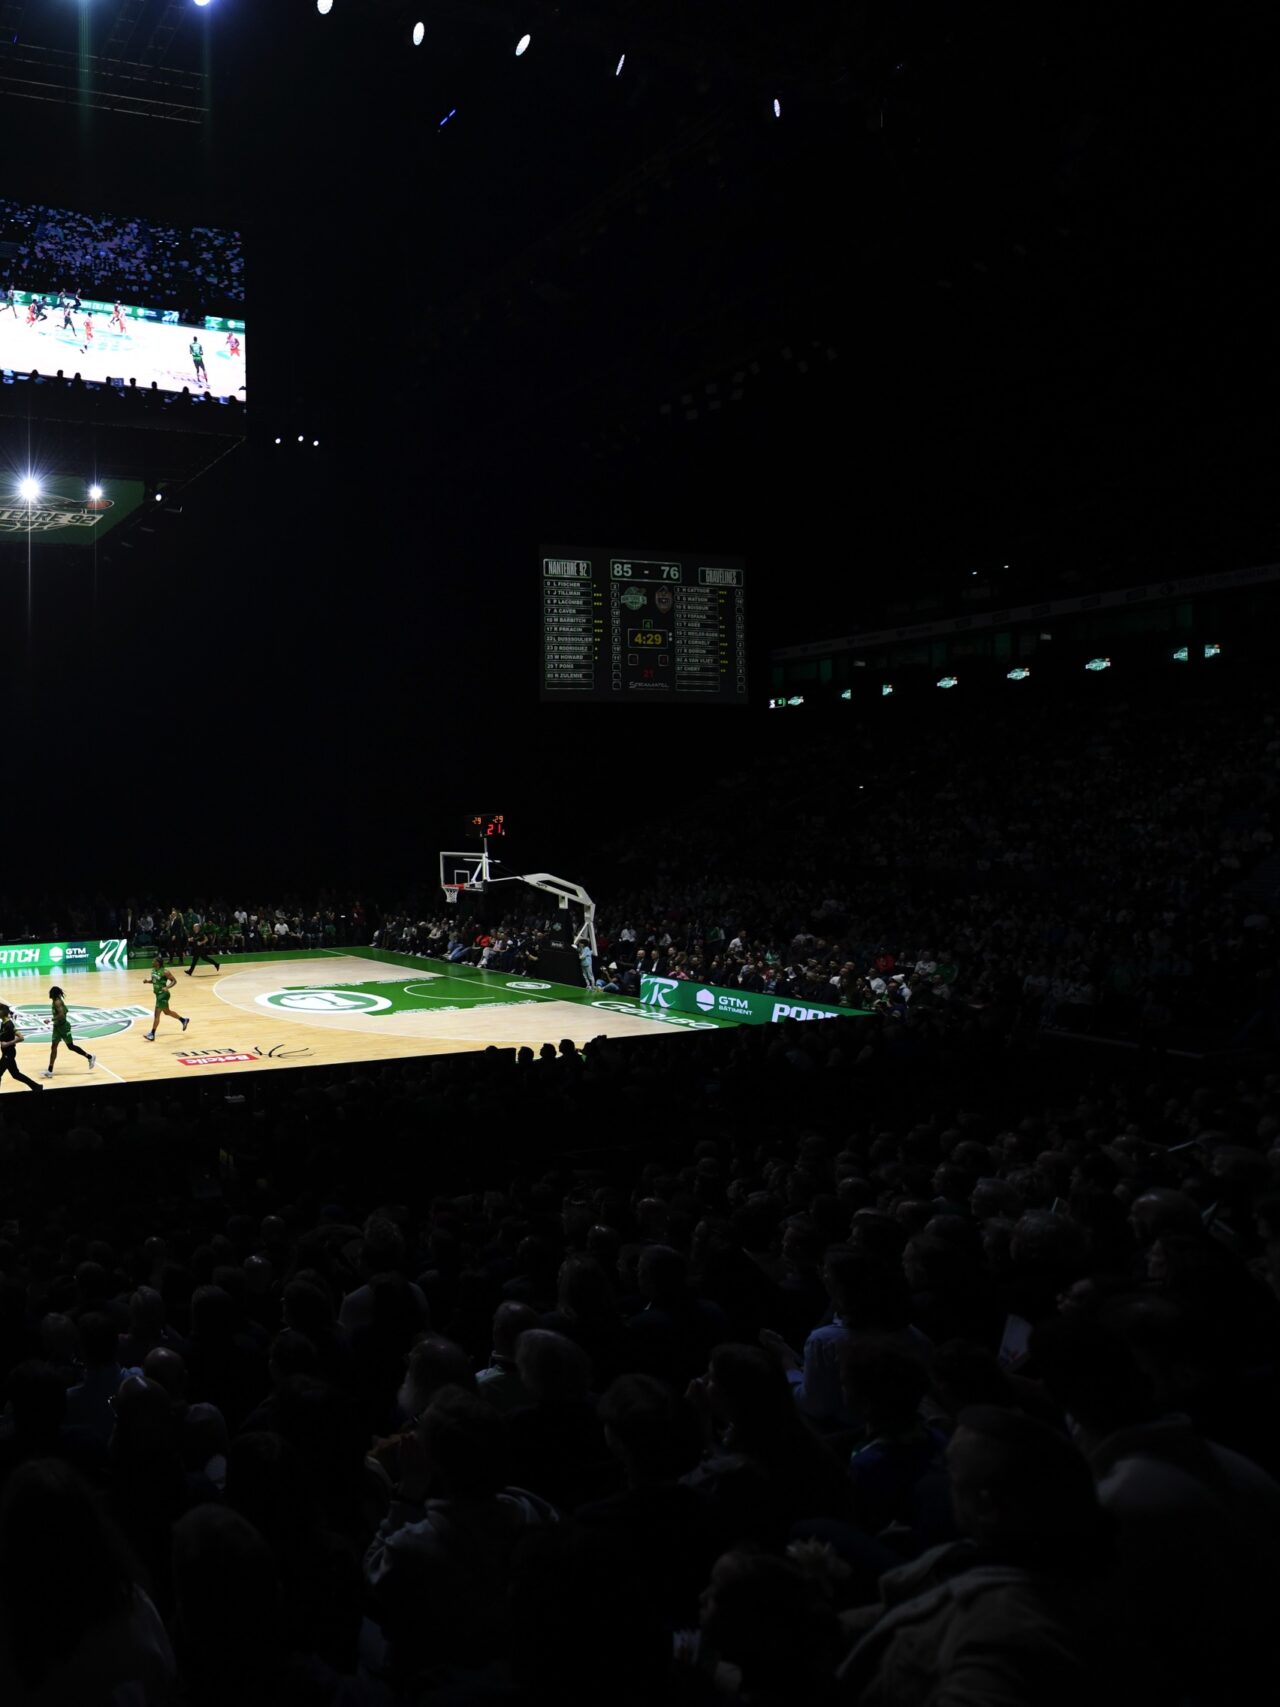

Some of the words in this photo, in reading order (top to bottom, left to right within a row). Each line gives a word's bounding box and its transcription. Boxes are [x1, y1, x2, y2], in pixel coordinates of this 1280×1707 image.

[70, 514, 100, 526] 92
[548, 560, 577, 576] NANTERRE
[613, 563, 632, 577] 85
[660, 566, 680, 579] 76
[705, 569, 736, 585] GRAVELINES
[634, 632, 662, 645] 4:29
[719, 996, 748, 1009] GTM
